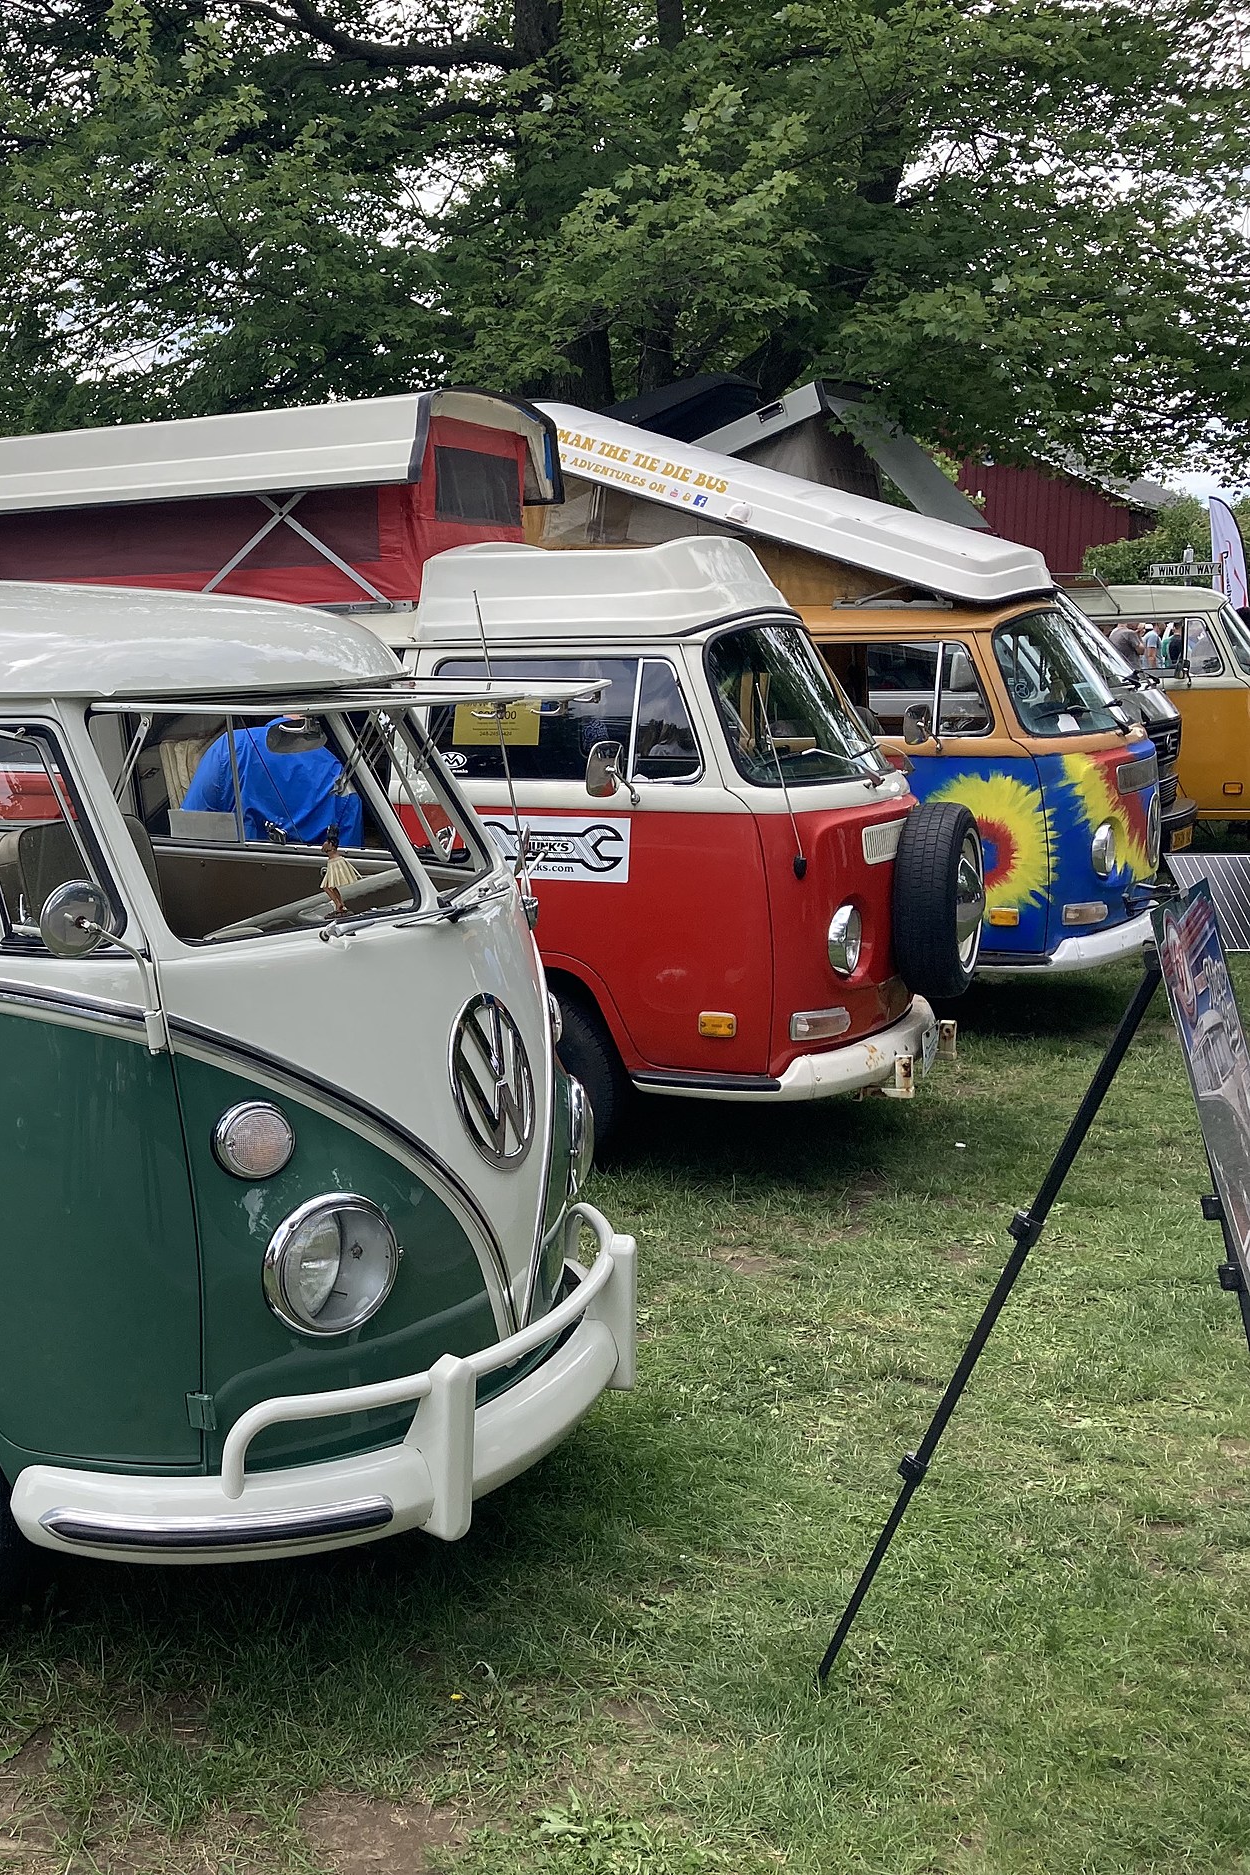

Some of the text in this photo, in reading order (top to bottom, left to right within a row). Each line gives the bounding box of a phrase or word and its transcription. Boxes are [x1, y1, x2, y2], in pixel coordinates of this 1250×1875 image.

[570, 457, 647, 487] ADVENTURES
[648, 481, 667, 494] ON
[597, 441, 631, 463] THE
[632, 452, 661, 472] TIE
[660, 462, 693, 482] DIE
[693, 472, 729, 493] BUS
[1158, 564, 1215, 576] WINTON WAY
